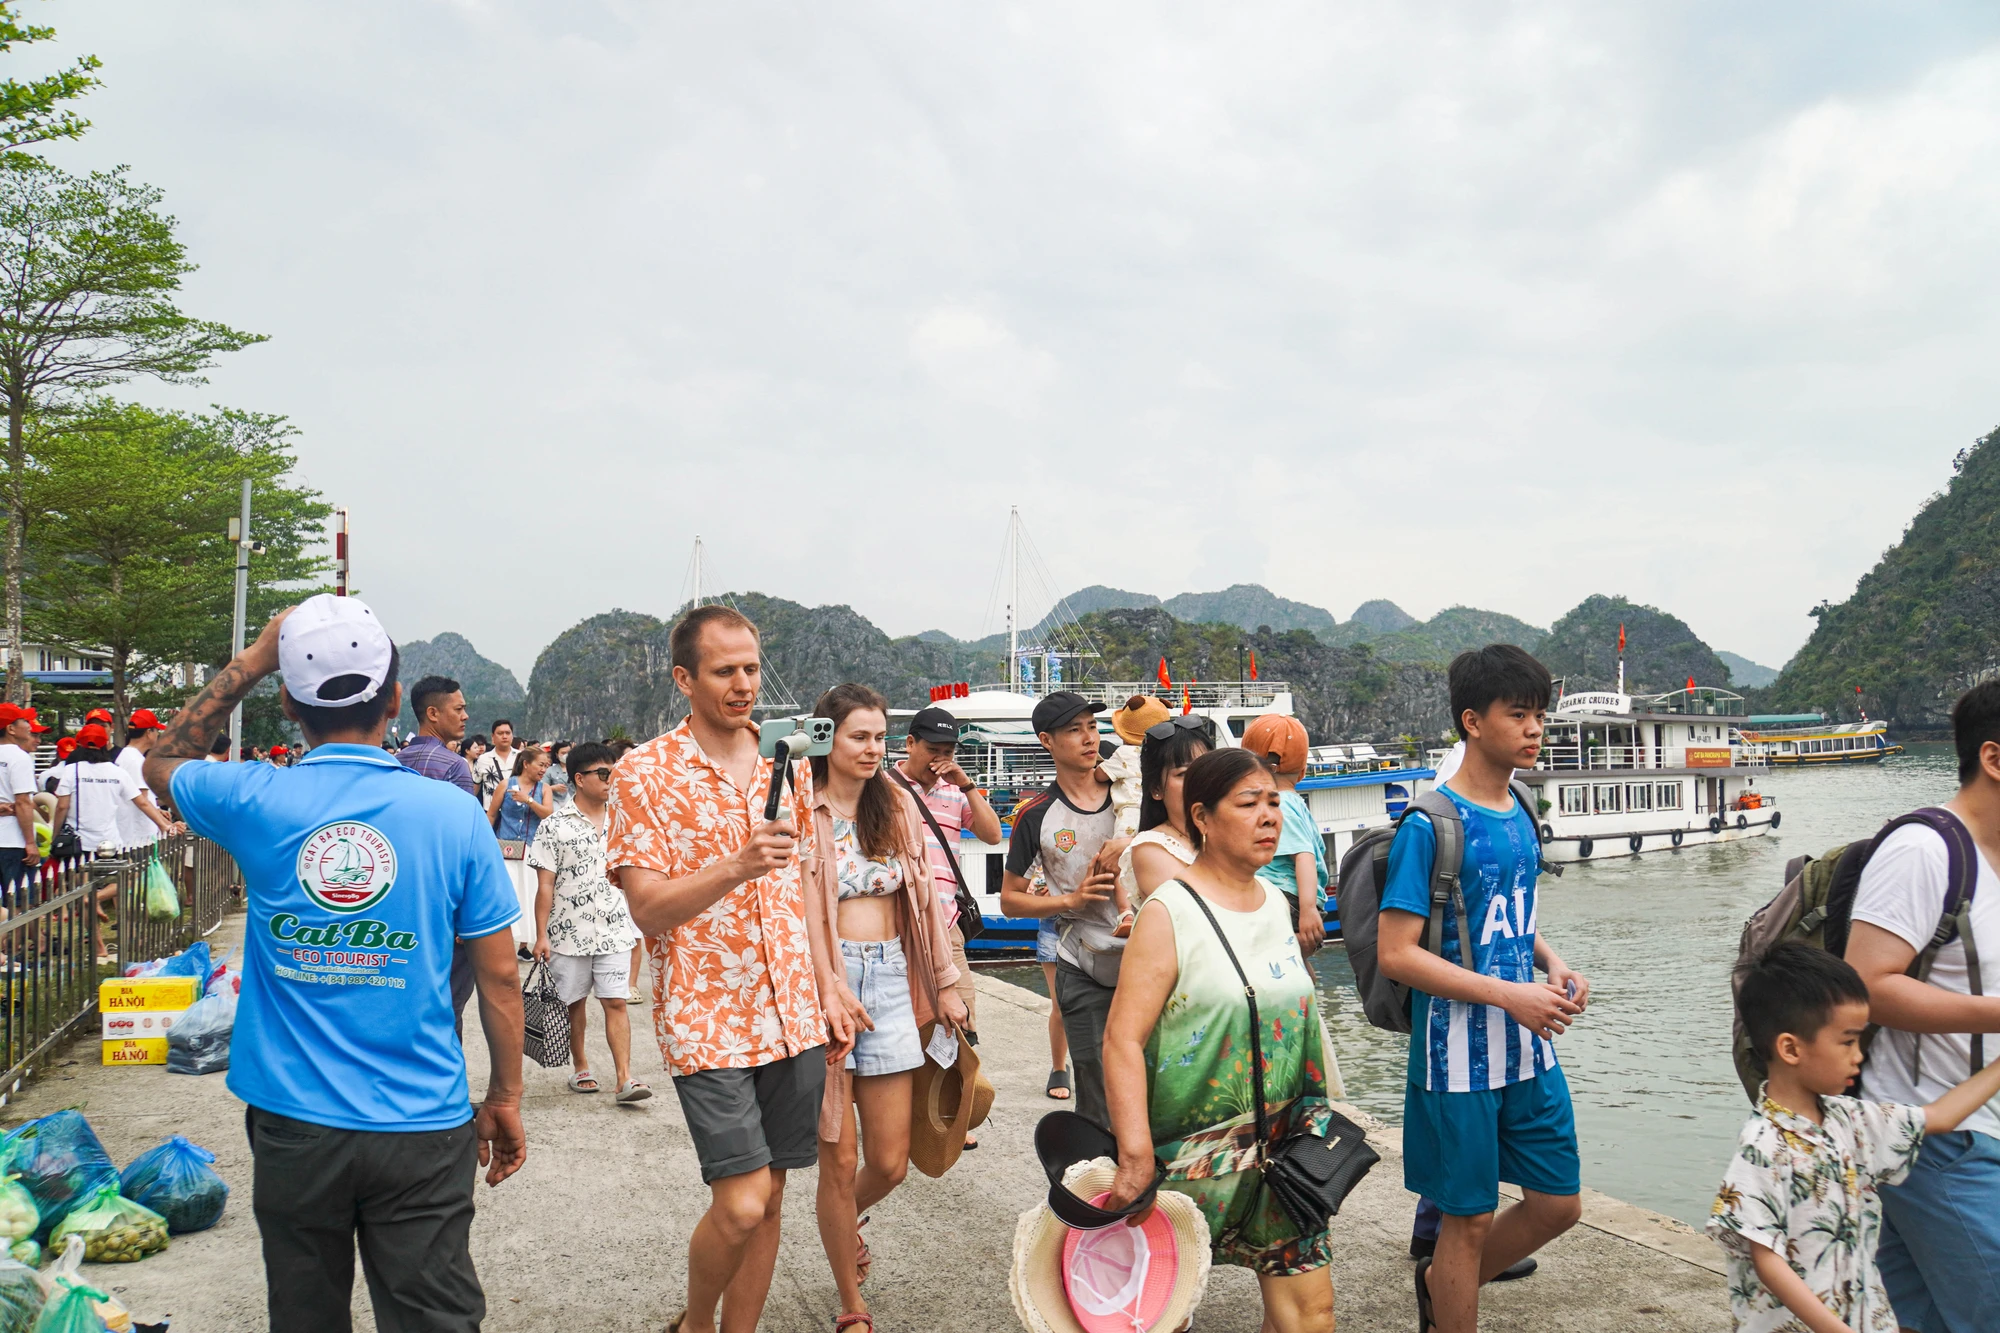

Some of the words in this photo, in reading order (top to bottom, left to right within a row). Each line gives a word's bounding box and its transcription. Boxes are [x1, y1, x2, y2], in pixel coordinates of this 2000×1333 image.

[1588, 696, 1620, 706] CRUISES
[937, 722, 953, 730] RELX
[304, 843, 319, 862] CAT
[318, 831, 333, 844] BA
[336, 827, 356, 837] ECO
[360, 830, 390, 864] TOURIST
[293, 949, 320, 963] ECO
[325, 952, 390, 966] TOURIST
[275, 966, 318, 983] HOTLINE:
[320, 975, 346, 985] +(84)
[348, 976, 366, 985] 989
[368, 976, 386, 985] 420
[388, 978, 405, 989] 112
[109, 996, 124, 1008] HÀ
[125, 996, 145, 1009] NỘI
[112, 1049, 127, 1061] HÀ
[128, 1049, 148, 1062] NỘI
